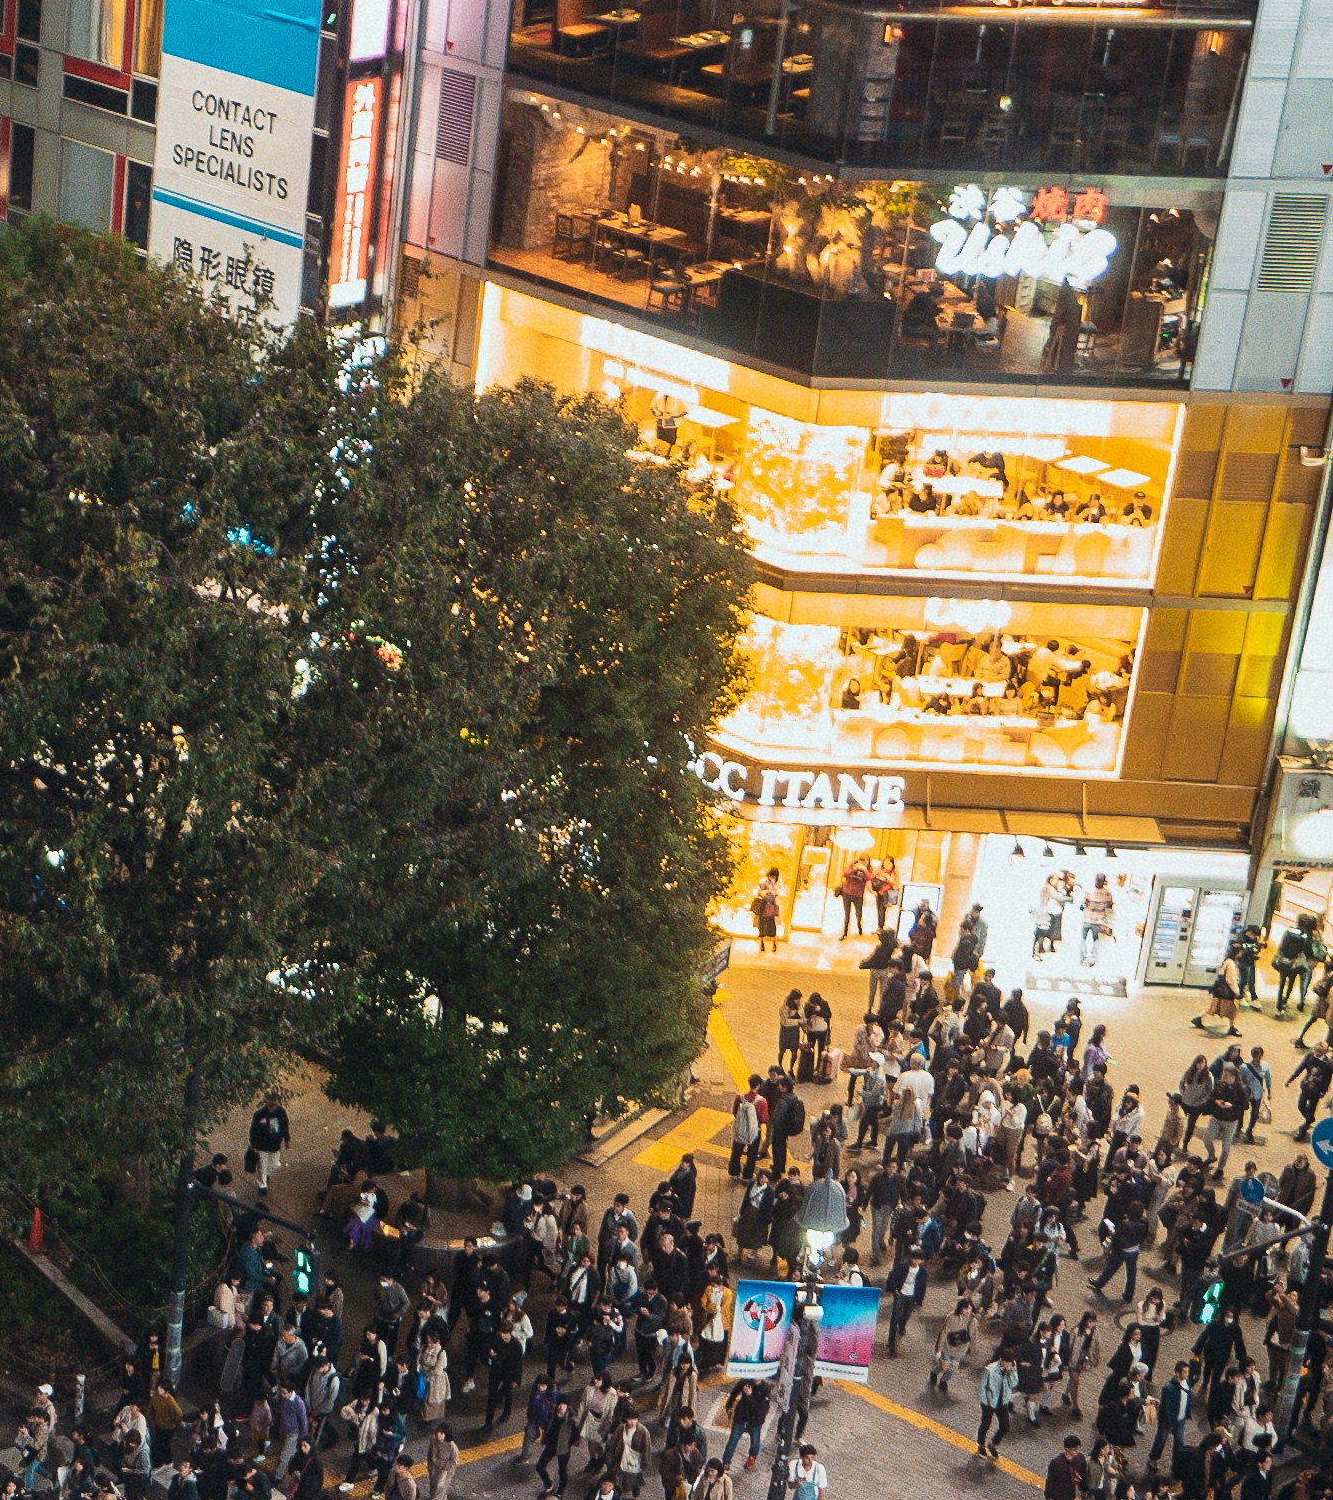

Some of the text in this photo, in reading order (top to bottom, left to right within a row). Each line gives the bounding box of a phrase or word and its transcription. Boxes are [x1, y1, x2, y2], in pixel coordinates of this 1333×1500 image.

[191, 89, 278, 136] CONTACT
[208, 123, 255, 158] LENS
[171, 143, 290, 201] SPECIALISTS
